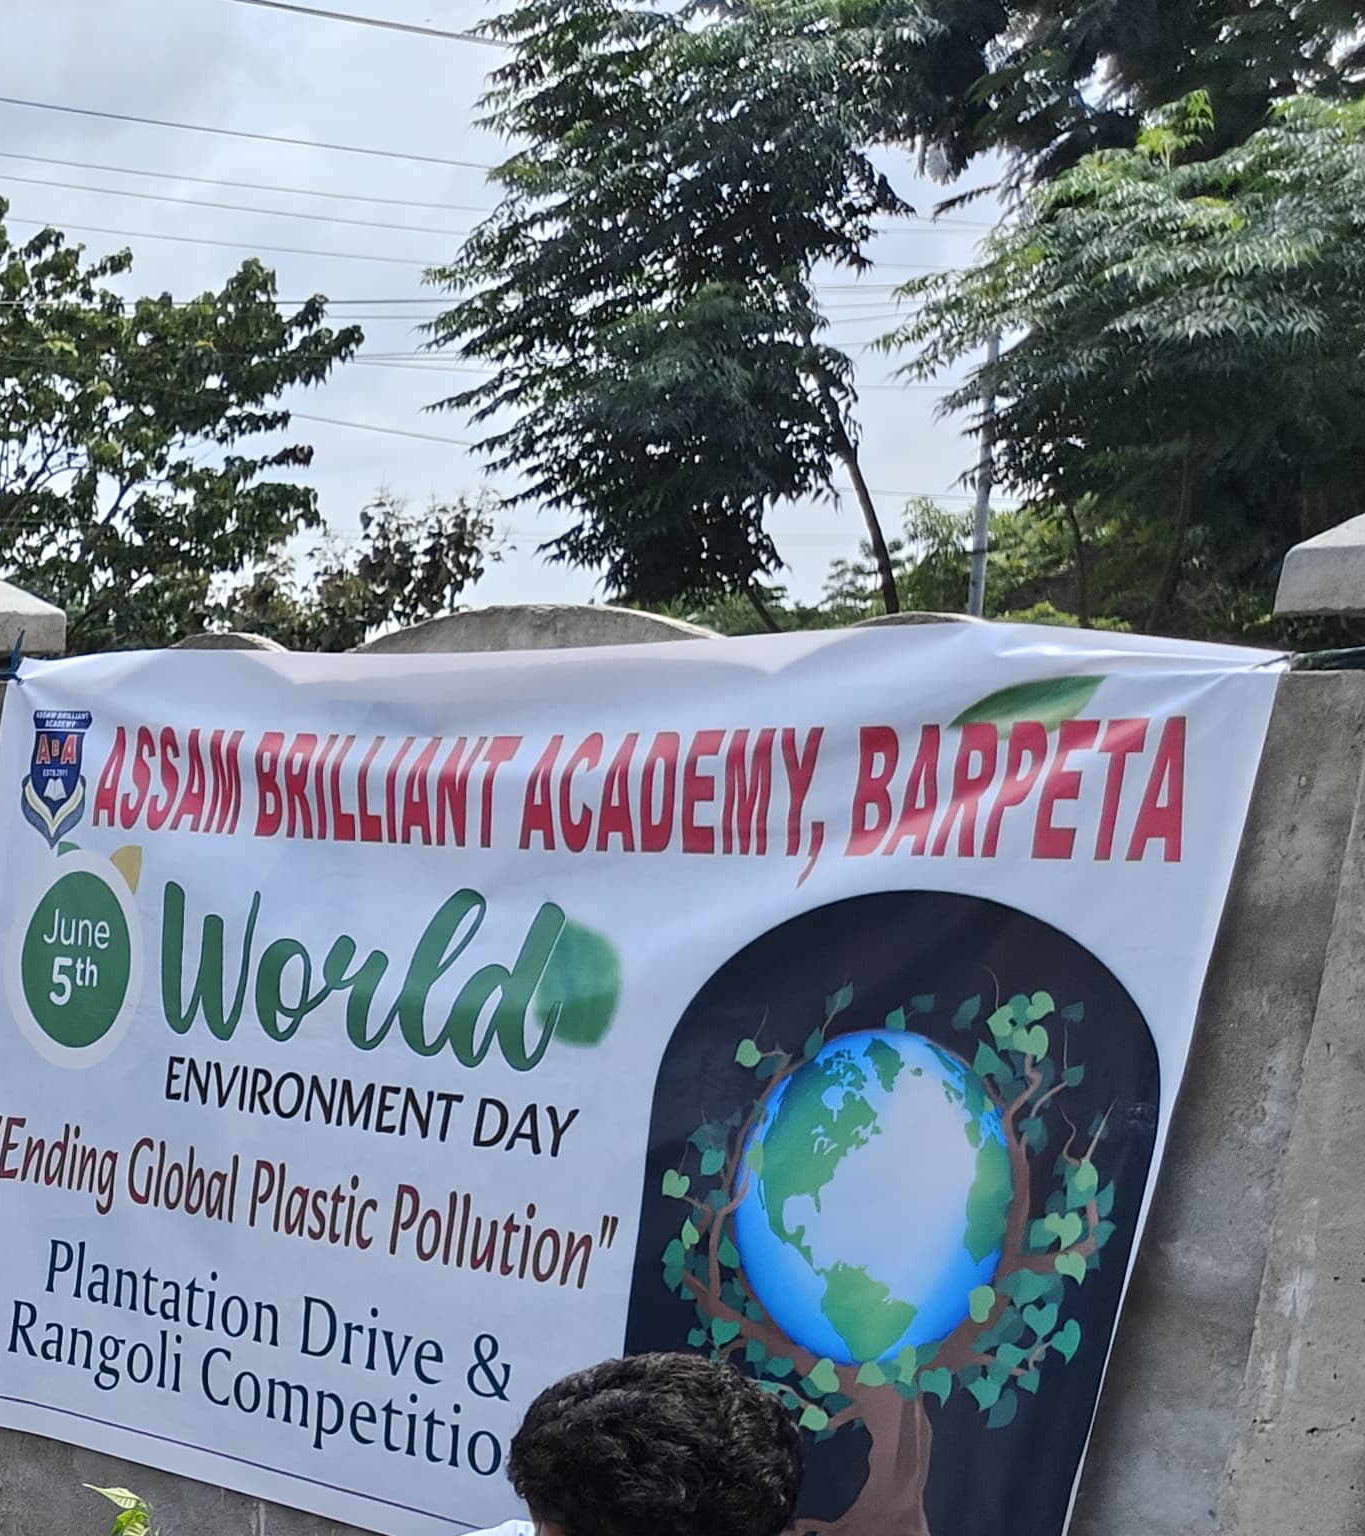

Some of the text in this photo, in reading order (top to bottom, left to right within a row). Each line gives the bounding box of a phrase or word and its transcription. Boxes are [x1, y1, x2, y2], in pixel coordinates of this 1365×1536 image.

[92, 715, 1187, 889] ASSAM BRILLIANT ACADEMY, BARPETA
[43, 908, 111, 950] June
[49, 955, 98, 1006] 5th
[161, 880, 567, 1072] World
[165, 1055, 580, 1158] ENVIRONMENT DAY
[127, 1136, 239, 1225] Global
[248, 1159, 378, 1251] Plastic
[389, 1183, 619, 1289] Pollution"
[7, 1299, 505, 1477] Rangoli Competitio
[44, 1238, 512, 1402] Plantation Drive &
